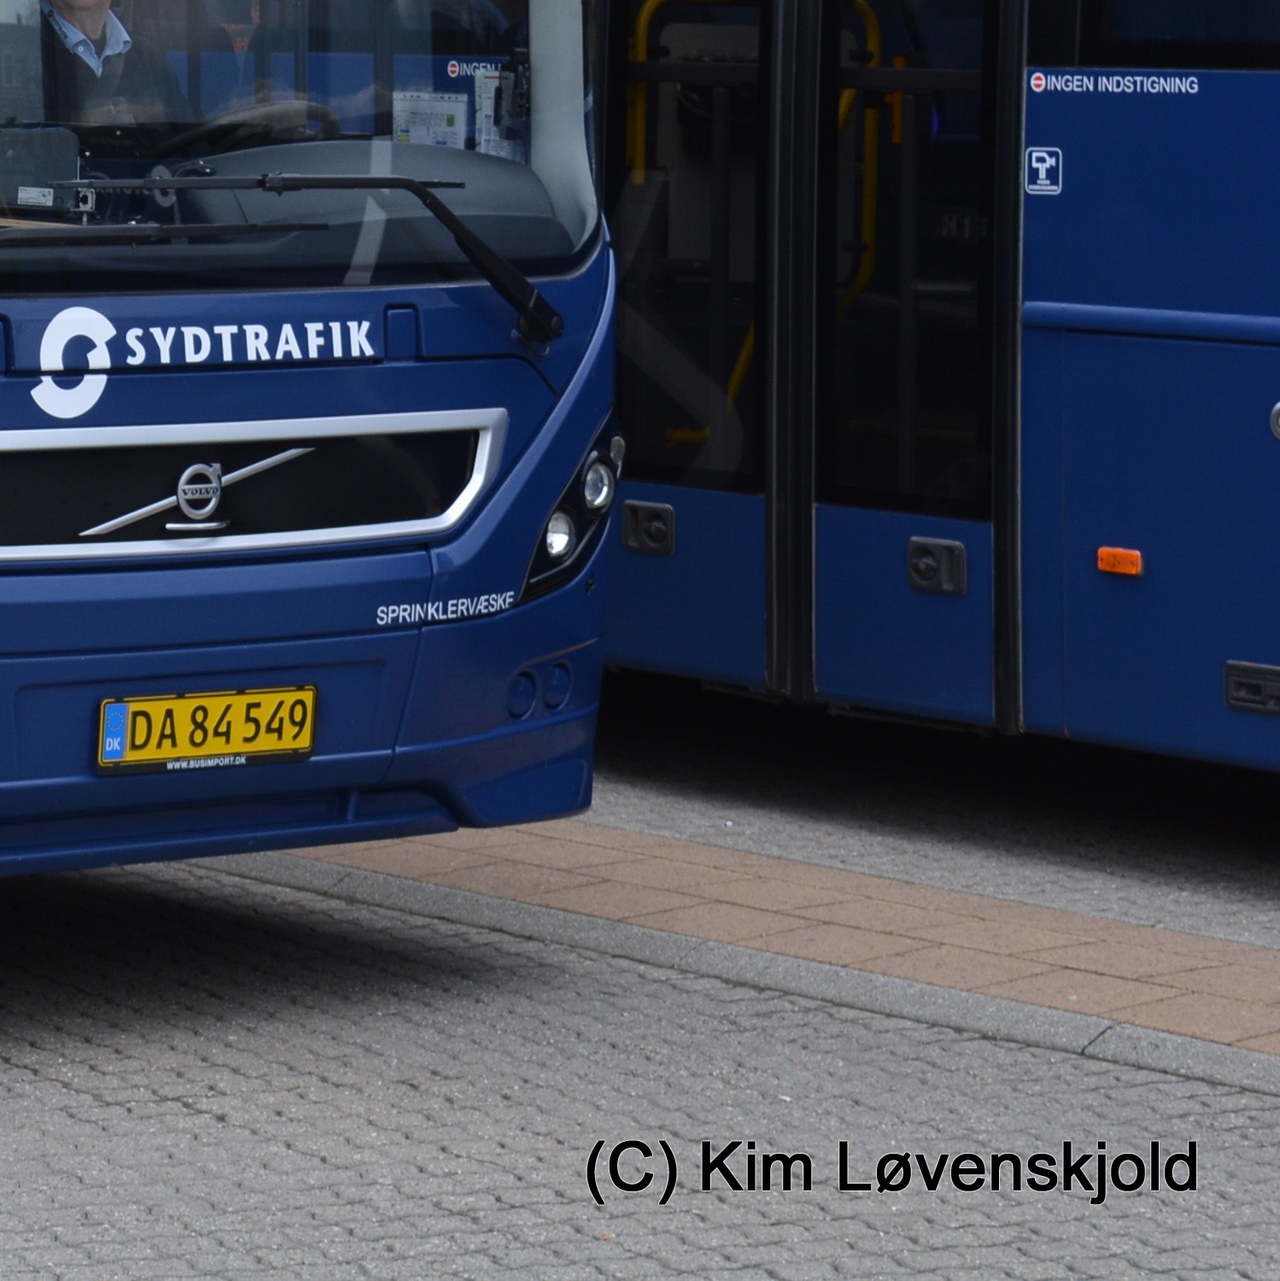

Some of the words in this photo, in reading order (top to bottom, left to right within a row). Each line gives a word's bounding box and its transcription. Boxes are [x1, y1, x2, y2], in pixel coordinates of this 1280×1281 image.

[1047, 74, 1094, 92] INGEN
[1098, 75, 1199, 94] INDSTIGNING
[123, 318, 376, 367] SYDTRAFIK
[181, 486, 219, 497] VOLVO
[375, 590, 515, 628] SPRINKLERVÆSKE
[129, 708, 178, 752] DA
[188, 703, 233, 748] 84
[242, 698, 308, 744] 549
[105, 737, 121, 751] DK
[166, 755, 247, 770] WWW.BUSIMPORT.DK
